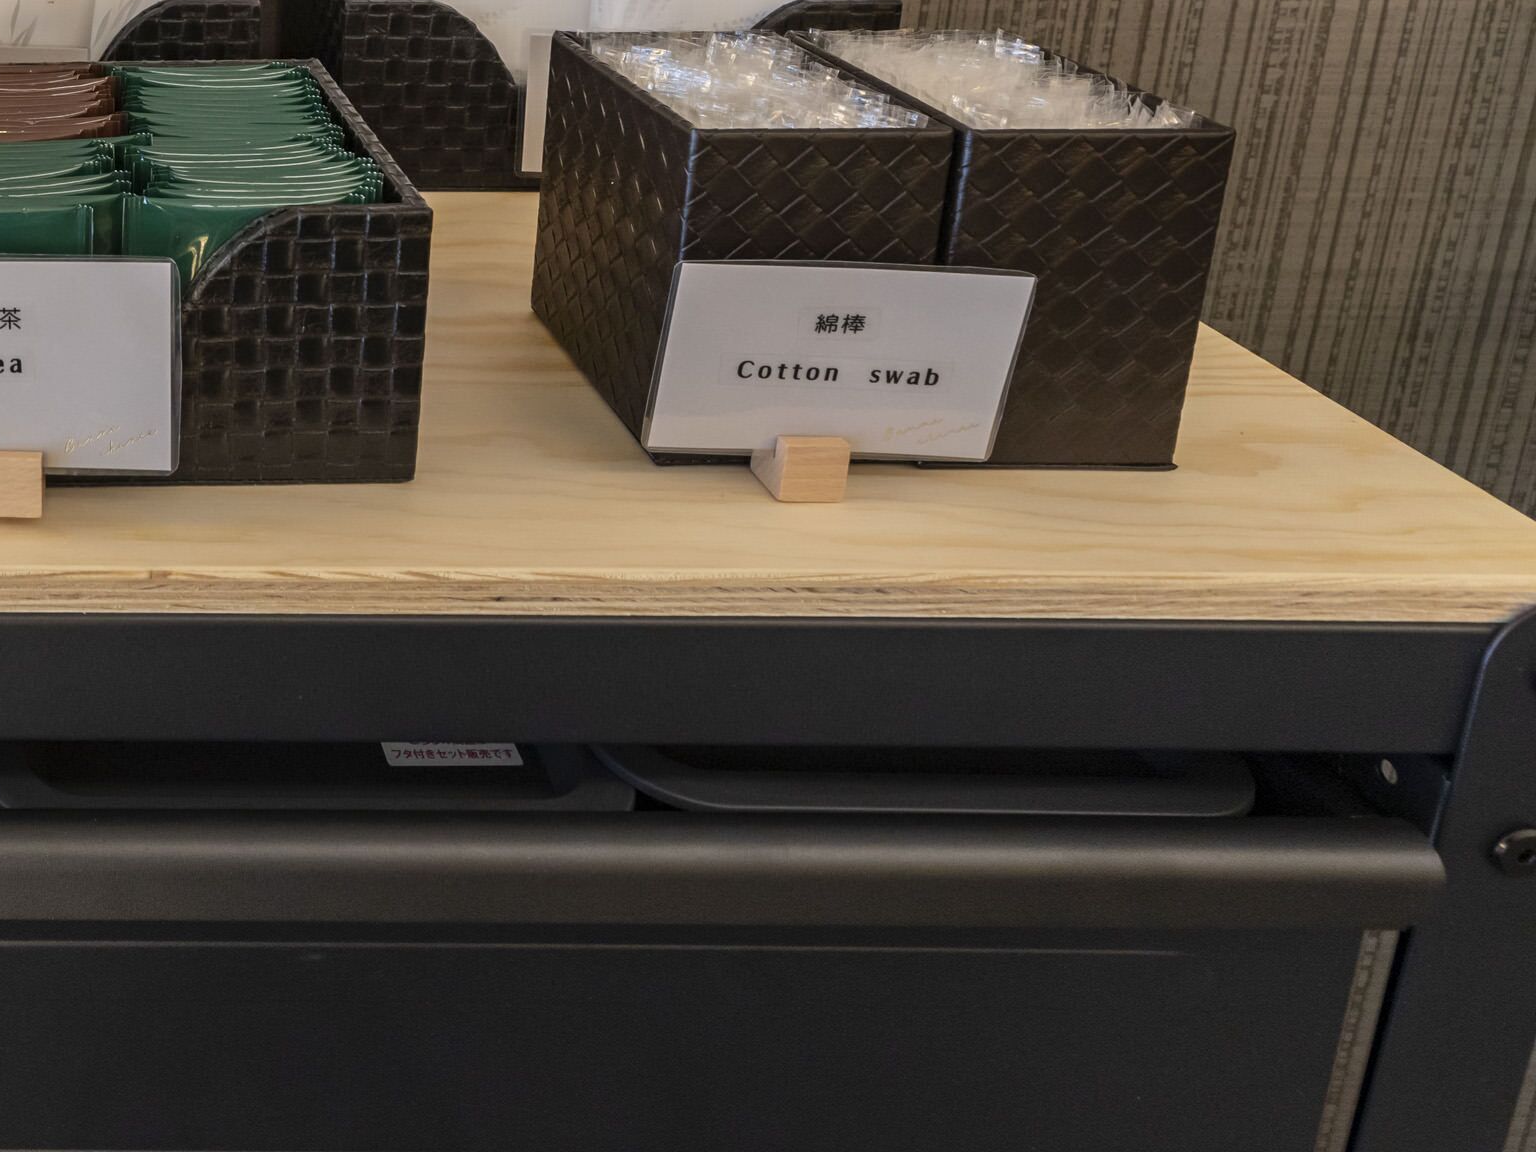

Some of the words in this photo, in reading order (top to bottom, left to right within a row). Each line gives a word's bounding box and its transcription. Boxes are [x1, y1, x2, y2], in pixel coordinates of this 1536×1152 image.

[813, 312, 867, 335] 綿棒
[736, 359, 840, 383] Cotton
[868, 367, 940, 387] swab
